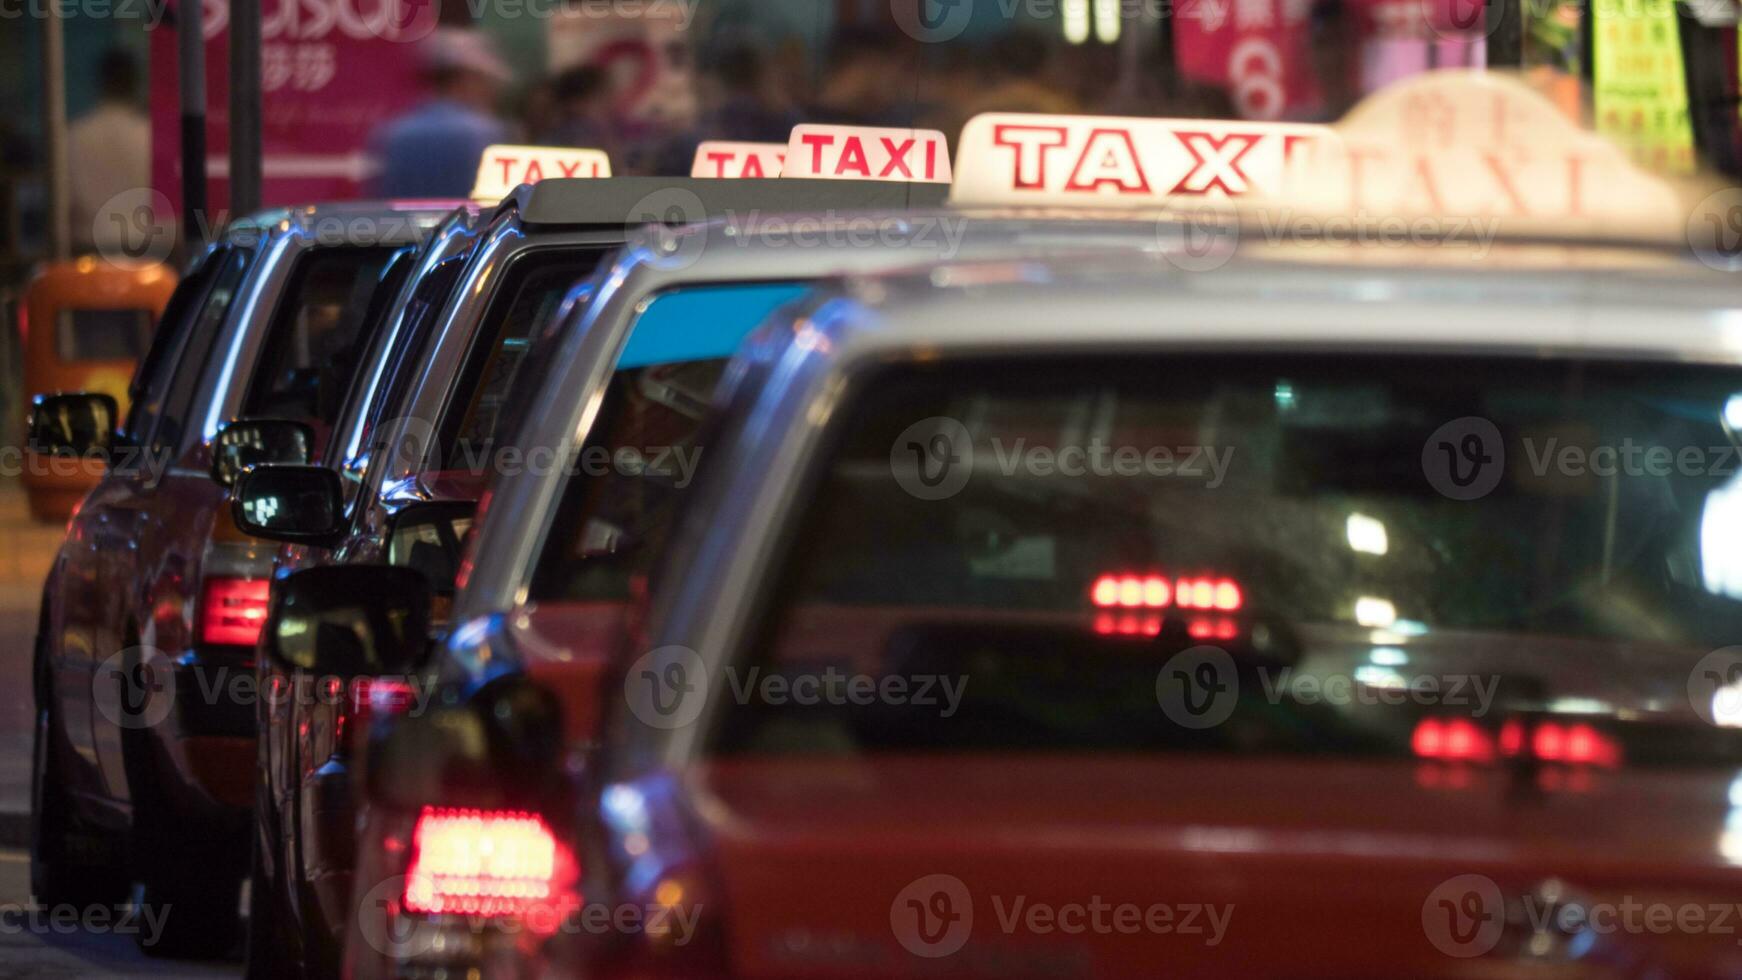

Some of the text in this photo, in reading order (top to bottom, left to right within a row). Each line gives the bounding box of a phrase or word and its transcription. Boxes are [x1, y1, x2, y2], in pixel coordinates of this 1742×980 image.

[495, 157, 600, 183] TAXI
[707, 152, 787, 178] TA
[802, 134, 936, 179] TAXI
[1348, 148, 1586, 217] TAXI
